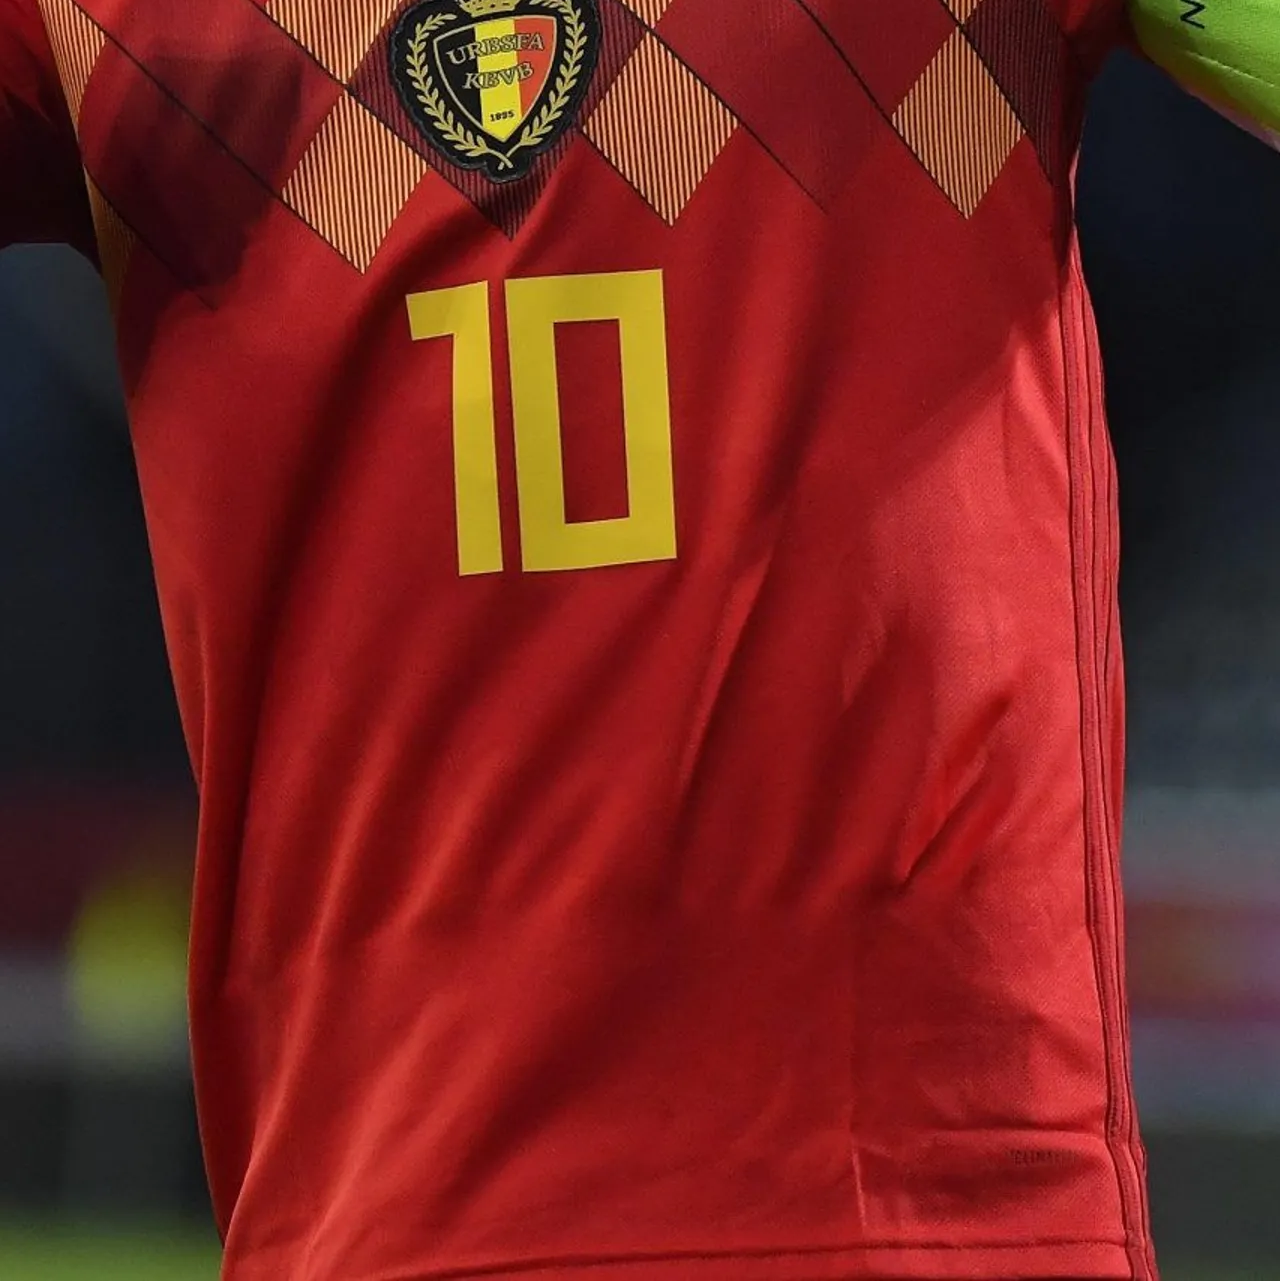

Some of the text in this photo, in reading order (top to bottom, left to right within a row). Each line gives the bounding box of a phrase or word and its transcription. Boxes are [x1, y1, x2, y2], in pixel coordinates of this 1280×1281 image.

[445, 31, 545, 65] URBSFA
[461, 61, 535, 90] KBVB
[405, 268, 677, 577] 10
